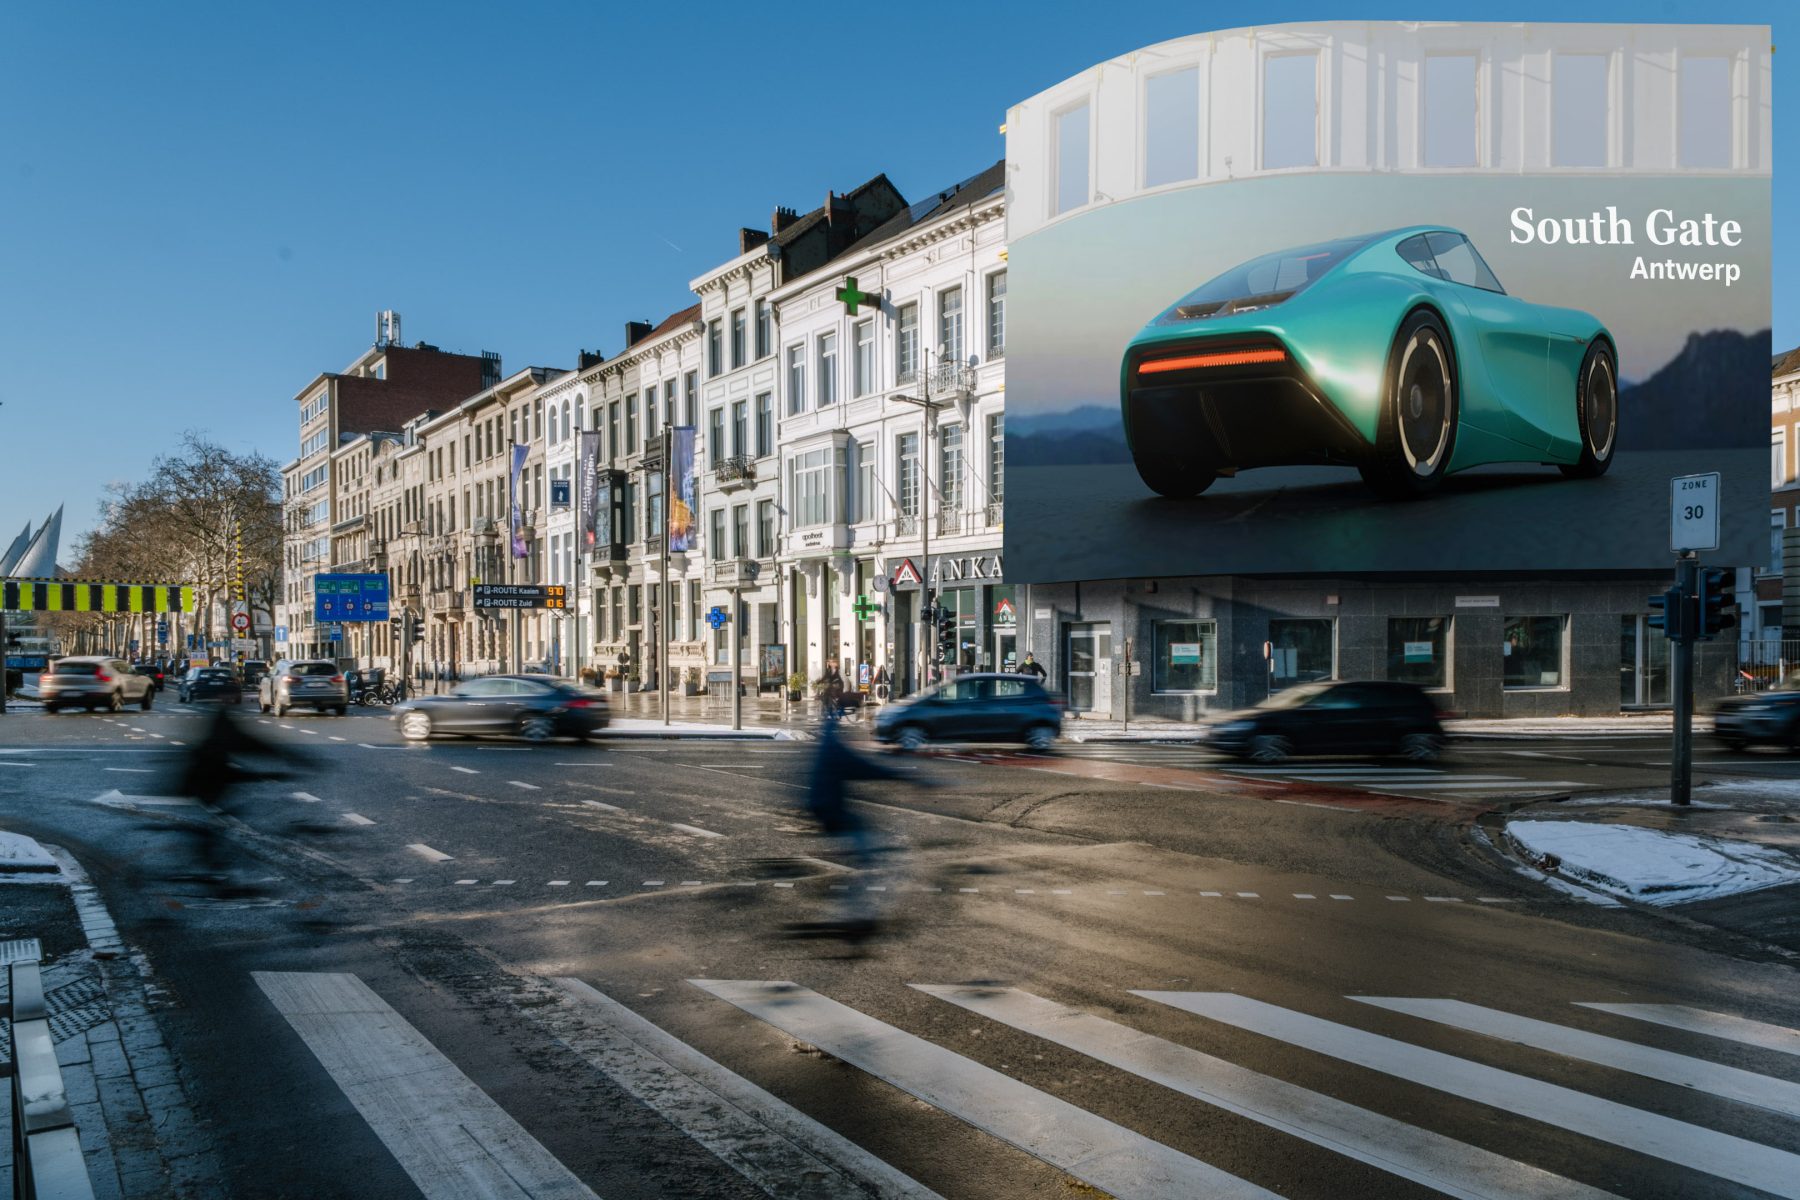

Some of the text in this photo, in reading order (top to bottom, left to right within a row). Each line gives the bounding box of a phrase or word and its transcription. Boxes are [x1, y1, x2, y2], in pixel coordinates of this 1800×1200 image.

[1510, 206, 1742, 246] South Gate
[1630, 256, 1741, 286] Antwerp
[1681, 480, 1707, 490] ZONE
[1684, 505, 1704, 520] 30
